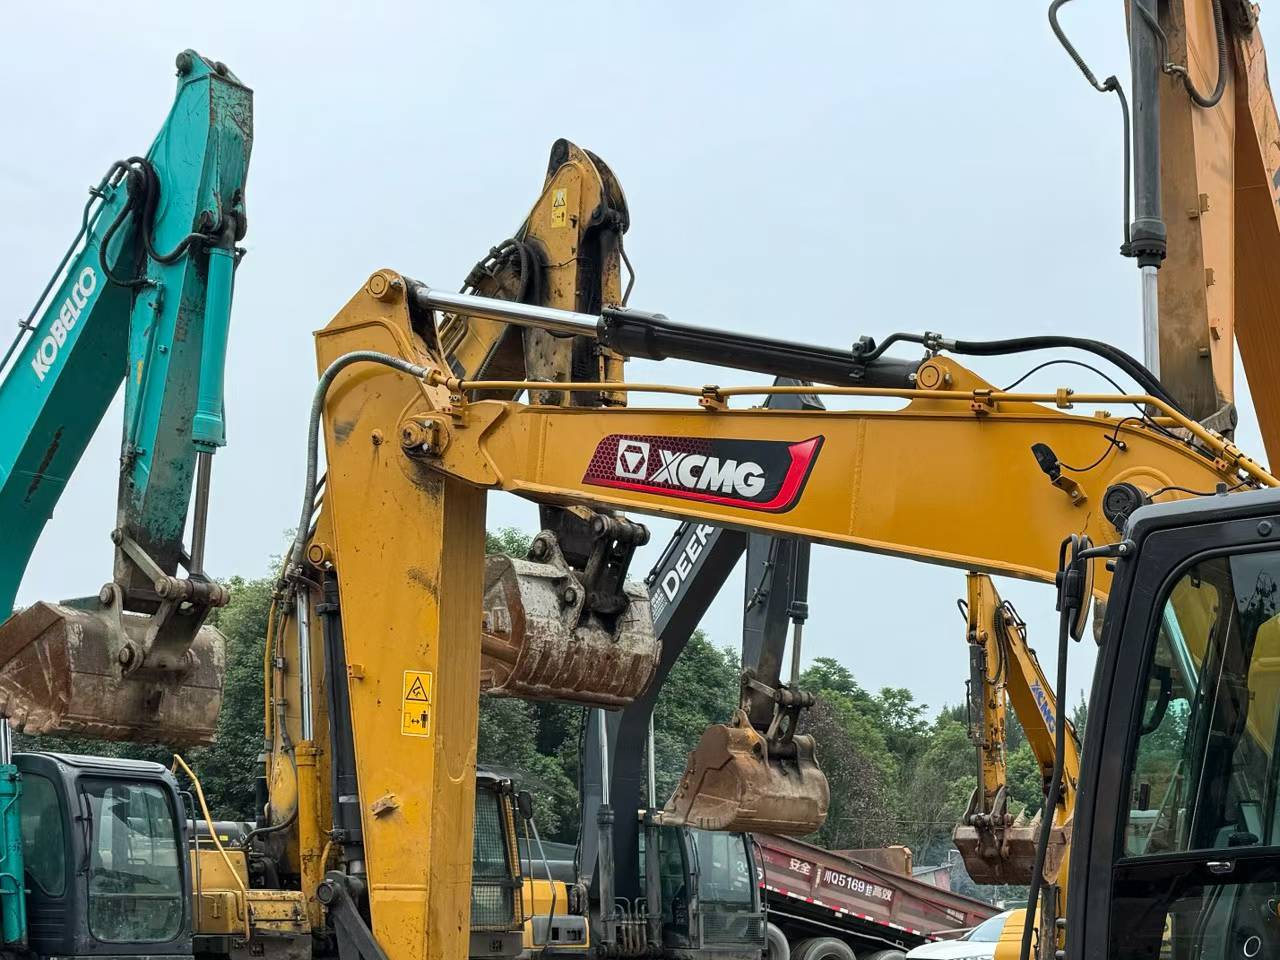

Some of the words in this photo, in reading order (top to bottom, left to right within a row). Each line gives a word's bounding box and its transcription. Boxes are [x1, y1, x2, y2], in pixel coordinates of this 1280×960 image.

[31, 266, 97, 382] KOBELCO
[649, 449, 766, 498] XCMG
[788, 857, 812, 876] 安全
